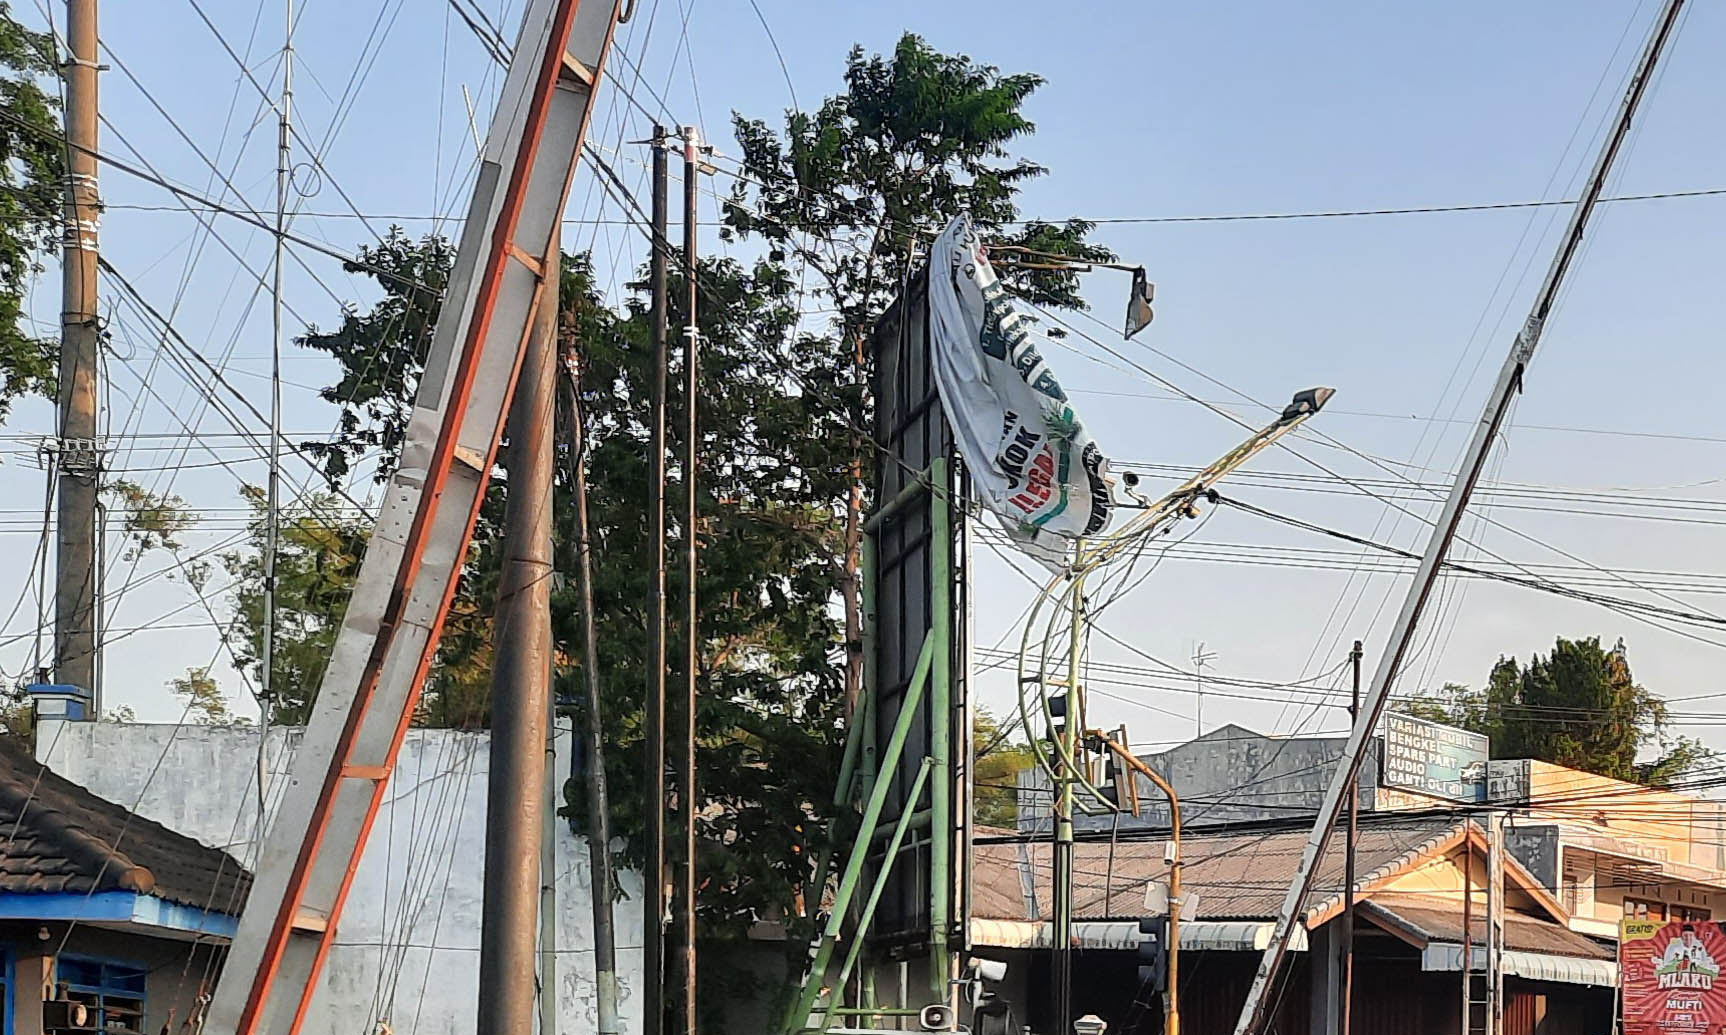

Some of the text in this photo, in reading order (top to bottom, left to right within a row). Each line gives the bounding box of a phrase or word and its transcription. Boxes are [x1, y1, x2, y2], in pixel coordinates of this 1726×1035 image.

[1389, 718, 1435, 738] VARIASI
[1389, 731, 1441, 753] BENGKEL
[1389, 744, 1457, 769] SPARE PART
[1389, 758, 1425, 775] AUDIO
[1388, 771, 1424, 788] GANTI
[1665, 1000, 1703, 1011] MUFTI
